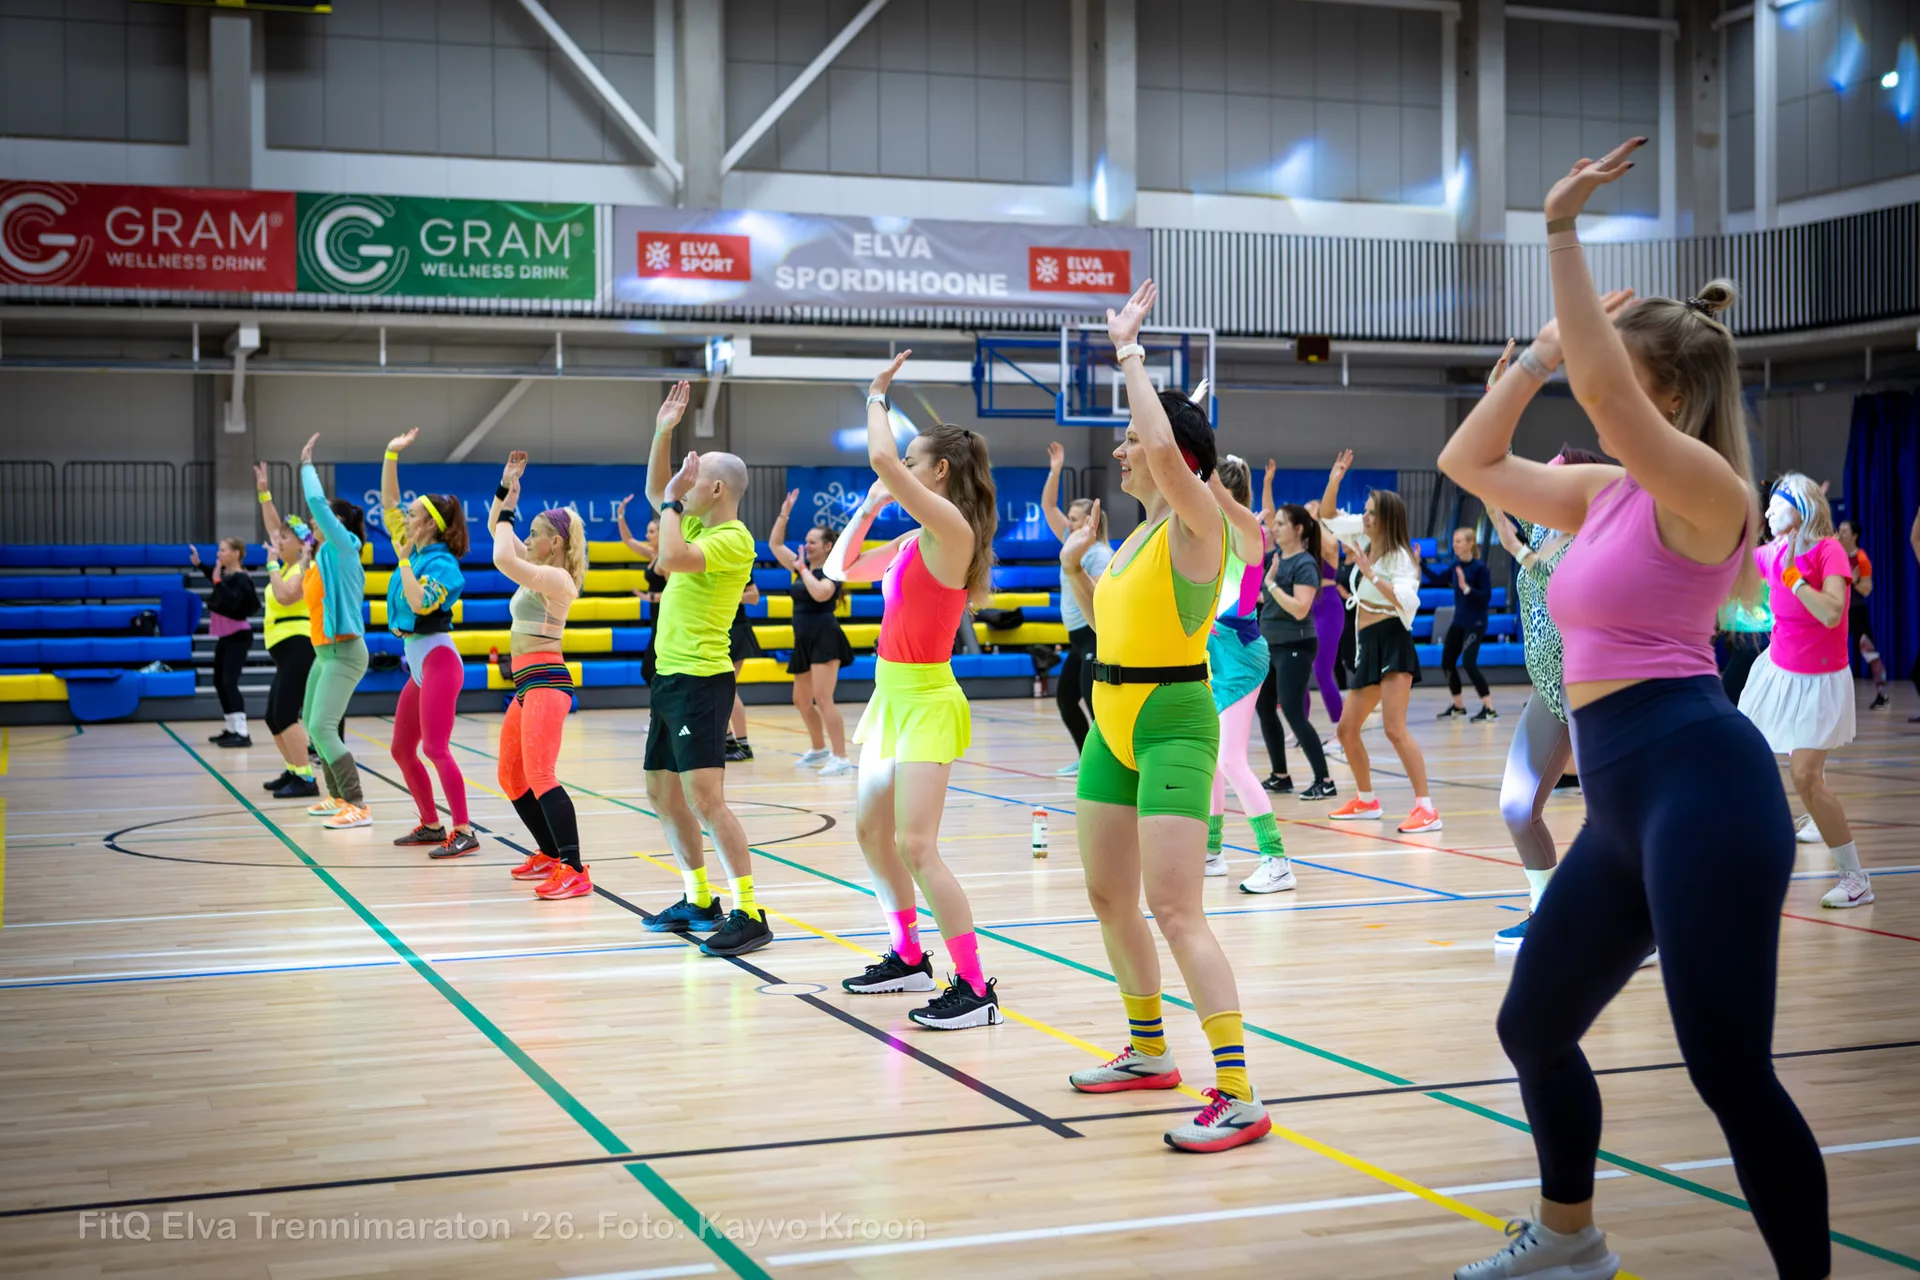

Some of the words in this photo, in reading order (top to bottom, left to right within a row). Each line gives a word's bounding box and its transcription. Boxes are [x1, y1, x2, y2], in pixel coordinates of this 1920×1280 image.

[680, 241, 719, 256] ELVA
[853, 233, 932, 259] ELVA
[106, 251, 208, 271] WELLNESS
[212, 254, 268, 272] DRINK
[681, 258, 733, 272] SPORT
[1066, 257, 1103, 270] ELVA
[421, 261, 516, 280] WELLNESS
[520, 263, 571, 280] DRINK
[1067, 272, 1115, 286] SPORT
[775, 266, 1009, 298] SPORDIHOONE
